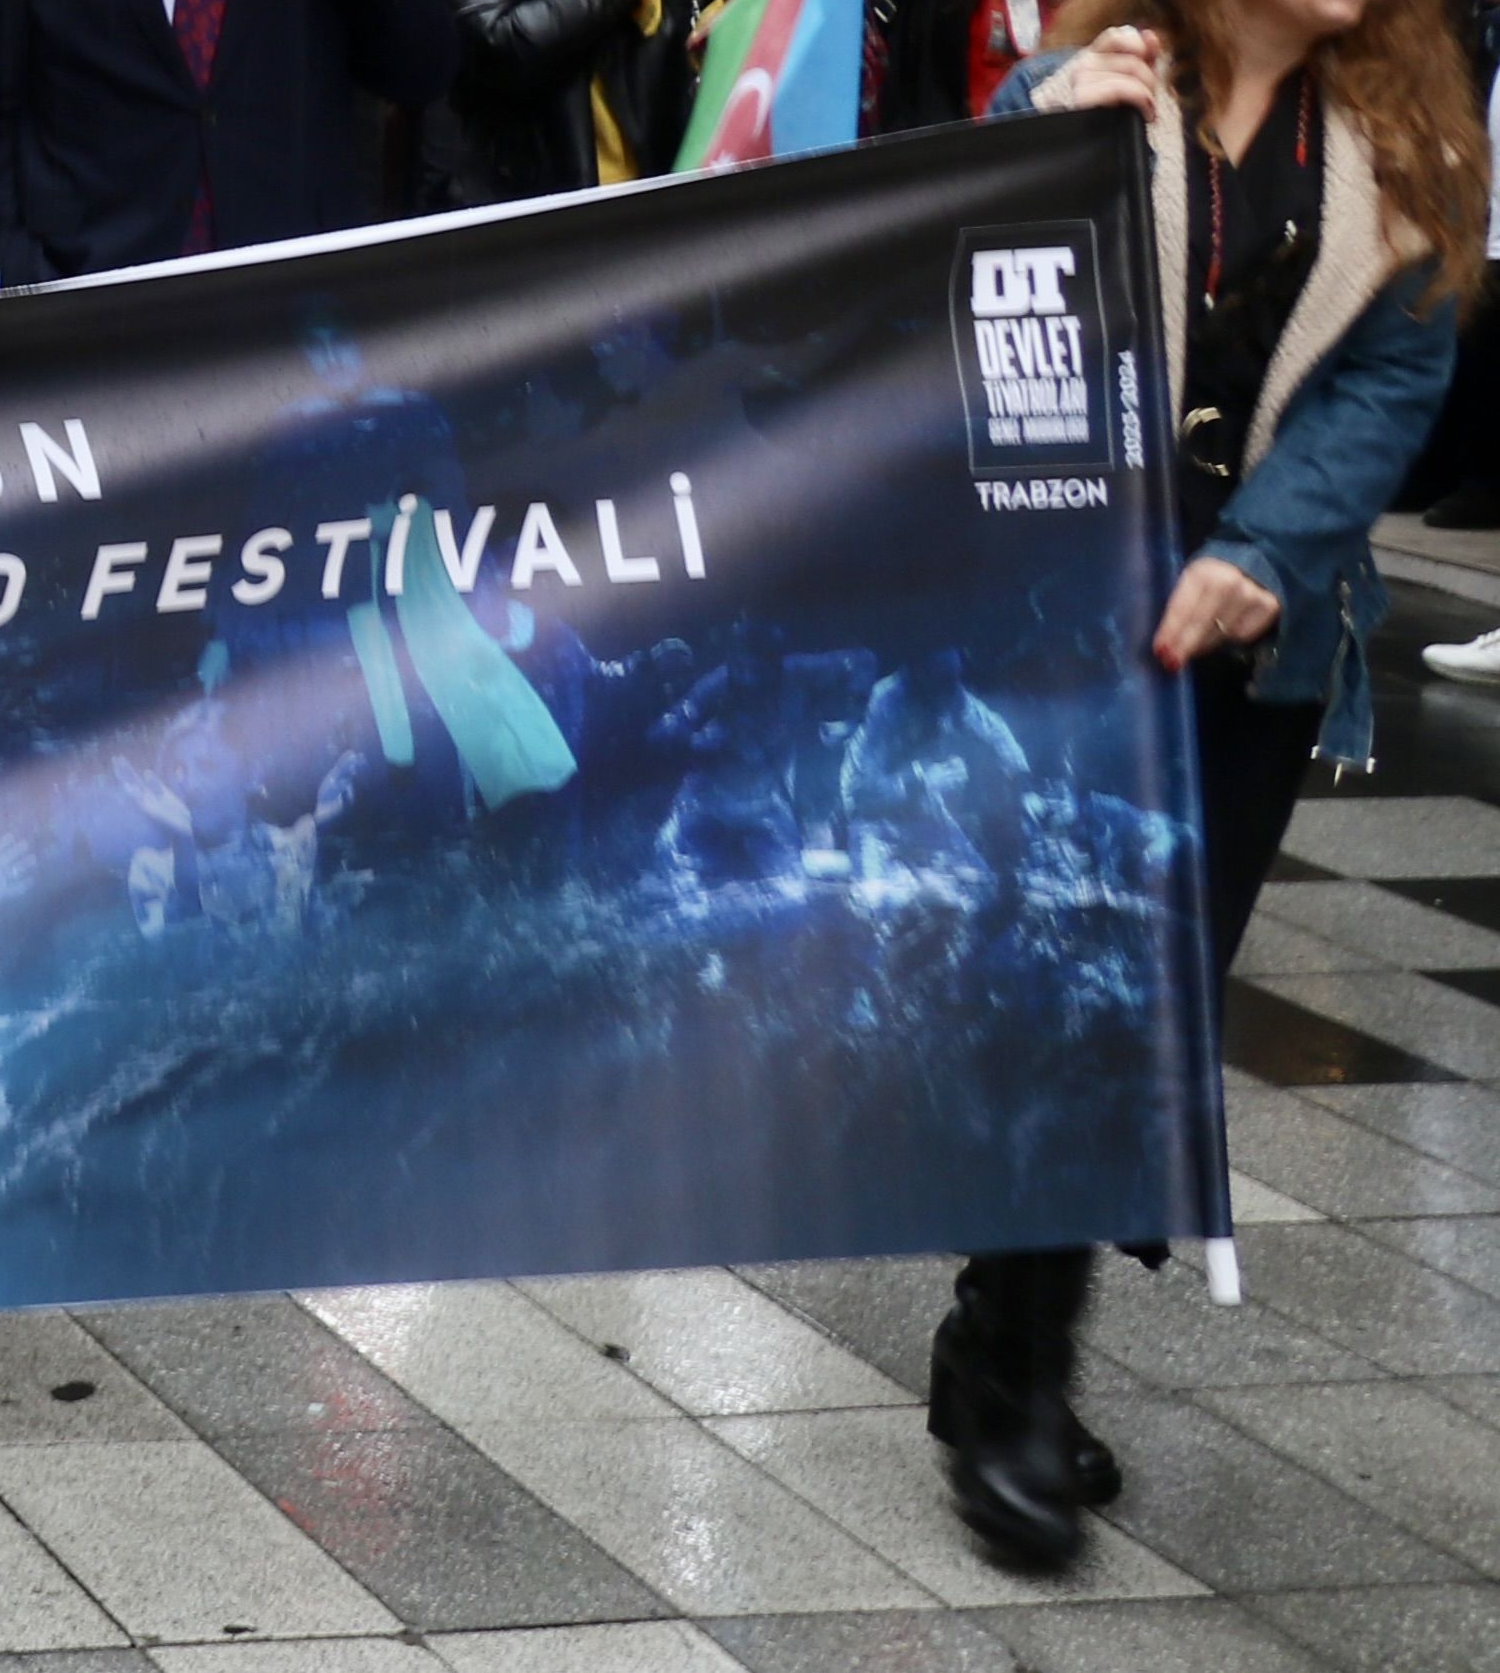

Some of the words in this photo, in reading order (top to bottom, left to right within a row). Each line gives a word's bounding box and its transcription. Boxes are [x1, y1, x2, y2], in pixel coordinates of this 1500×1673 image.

[973, 315, 1084, 380] DEVLET
[973, 476, 1109, 512] TRABZON
[83, 470, 707, 620] FESTİVALİ
